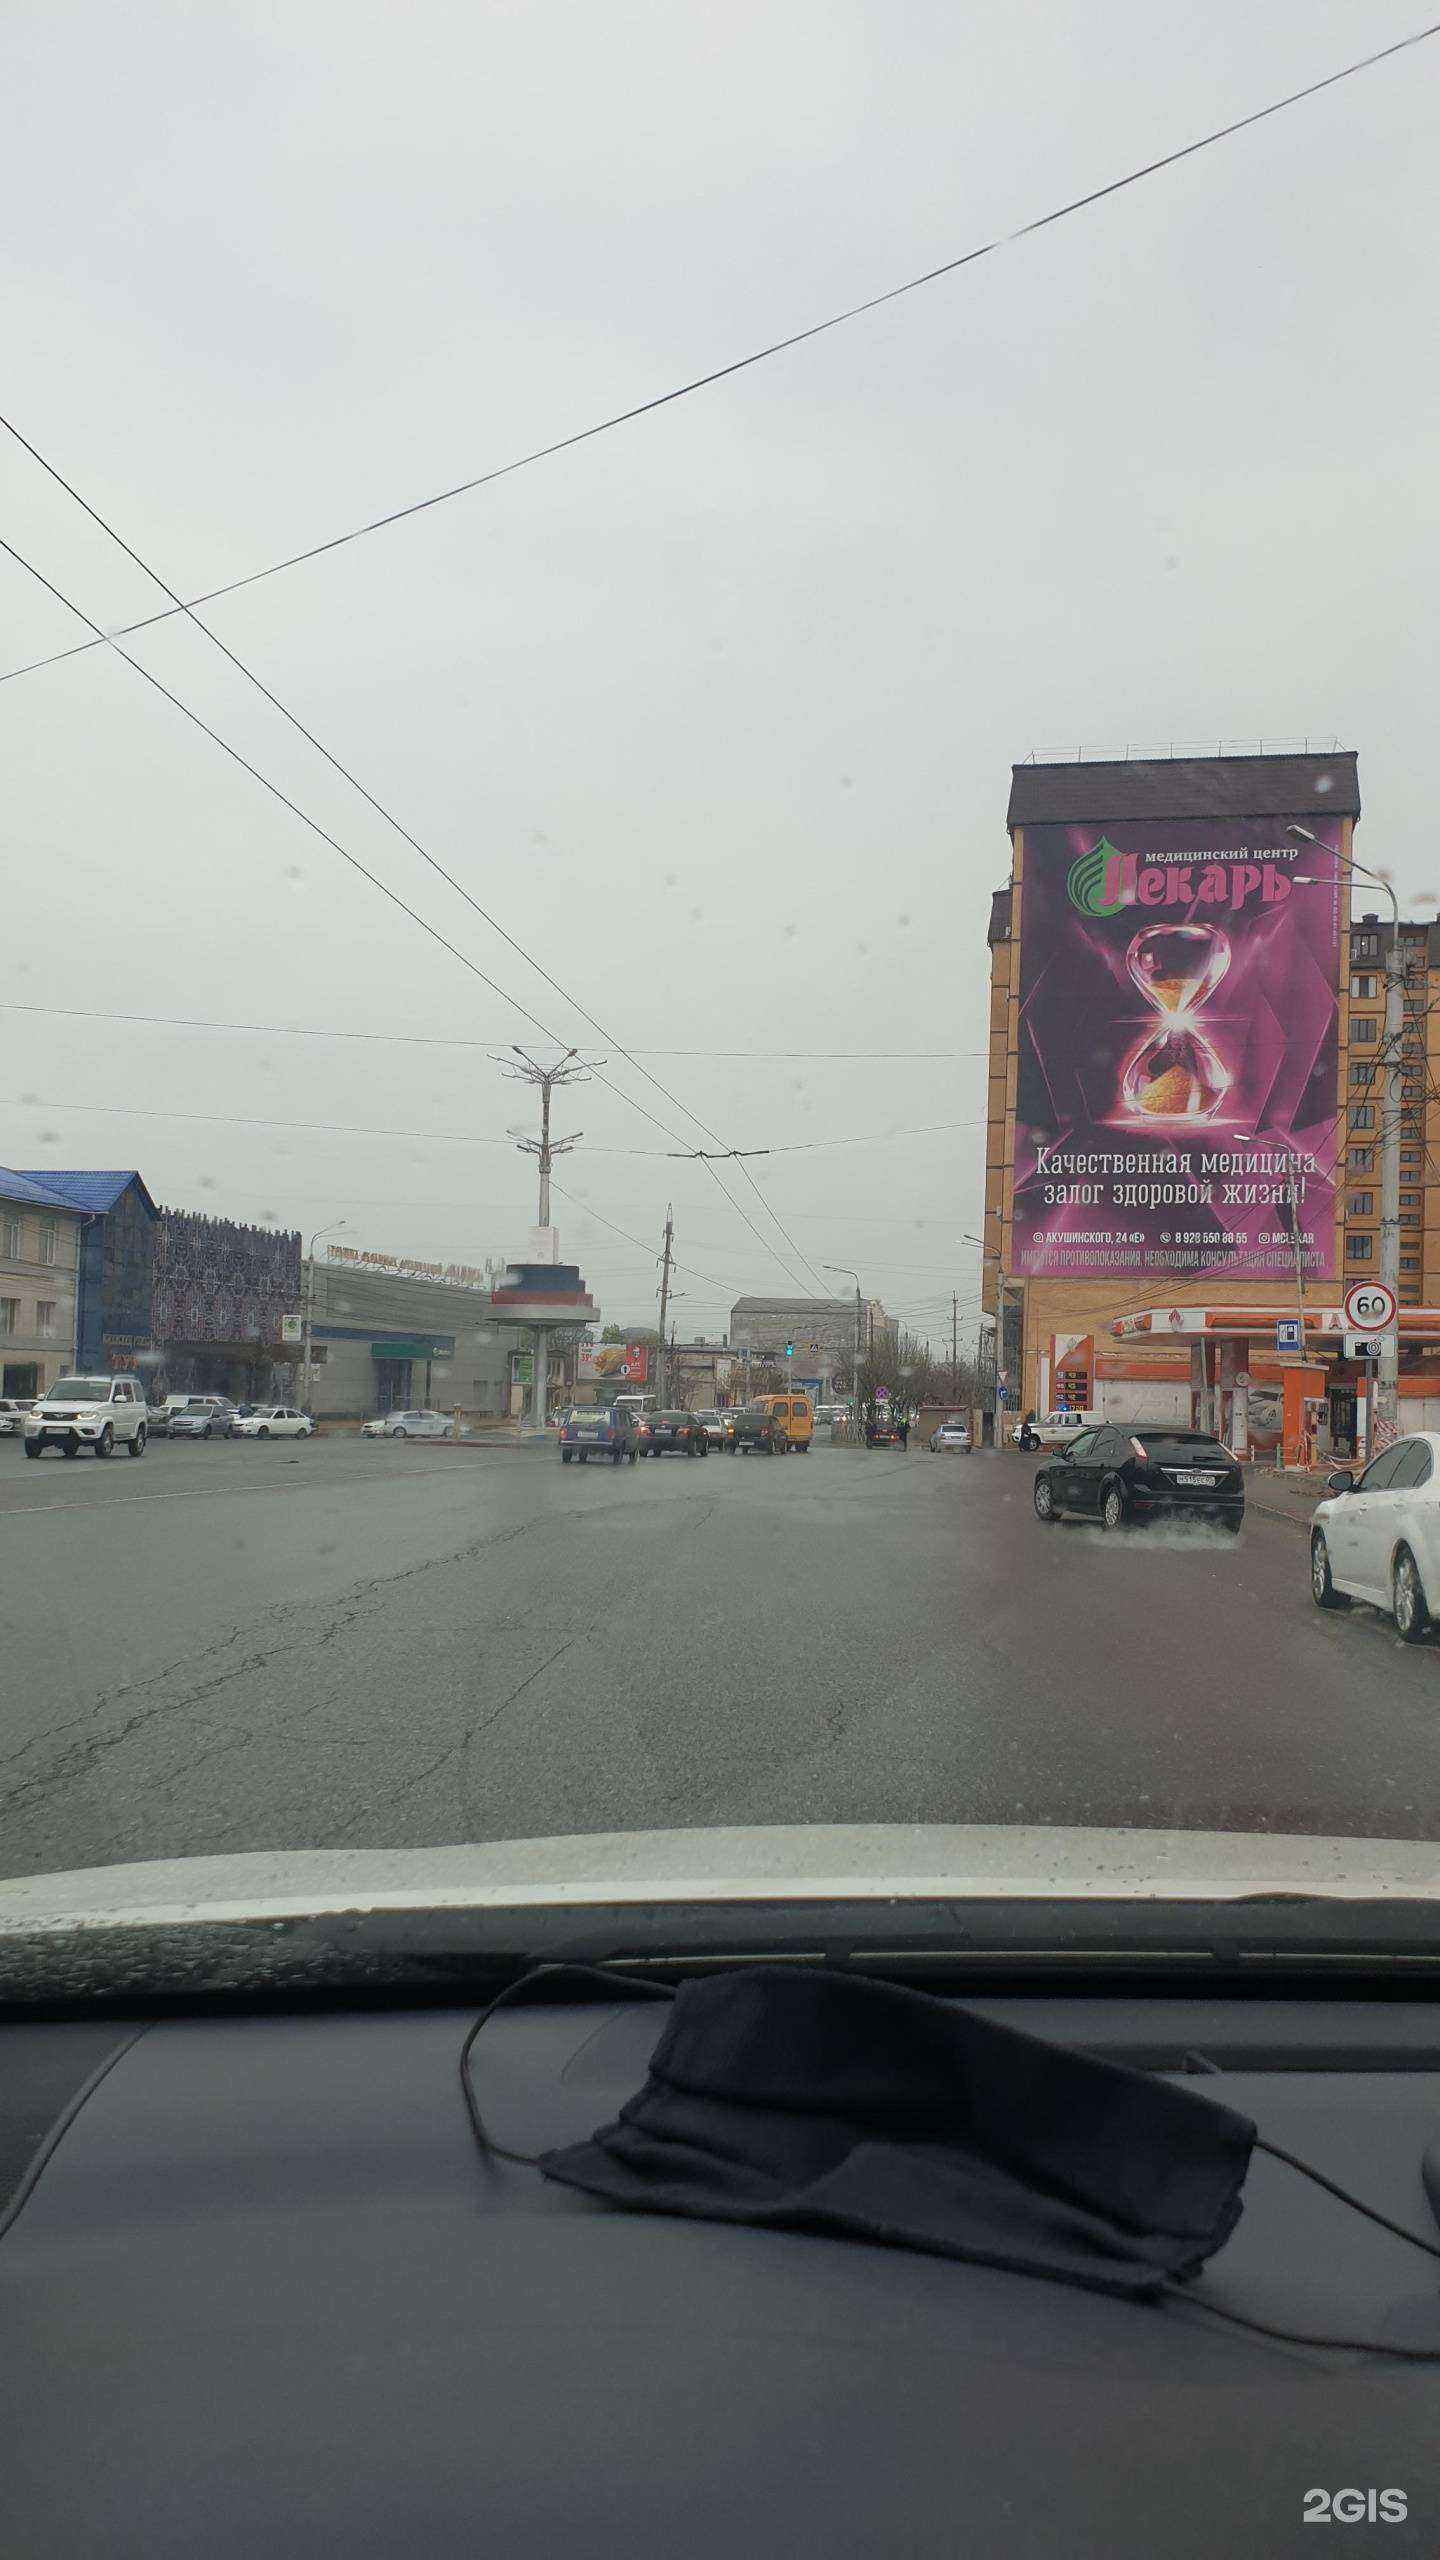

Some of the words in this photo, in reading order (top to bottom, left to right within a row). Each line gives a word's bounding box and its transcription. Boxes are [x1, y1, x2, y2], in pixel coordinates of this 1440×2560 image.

[1145, 847, 1248, 863] медицинский
[1253, 848, 1298, 861] центр
[1101, 853, 1292, 910] Лекарь
[1036, 1147, 1192, 1174] Качественная
[1201, 1152, 1316, 1176] медицина
[1044, 1183, 1103, 1204] залог
[1112, 1179, 1213, 1209] здоровой
[1046, 1232, 1114, 1244] АКУШИНСКОГО,
[1115, 1232, 1127, 1243] 24
[1175, 1232, 1181, 1243] 8
[1236, 1232, 1248, 1244] 55
[1357, 1296, 1385, 1316] 60
